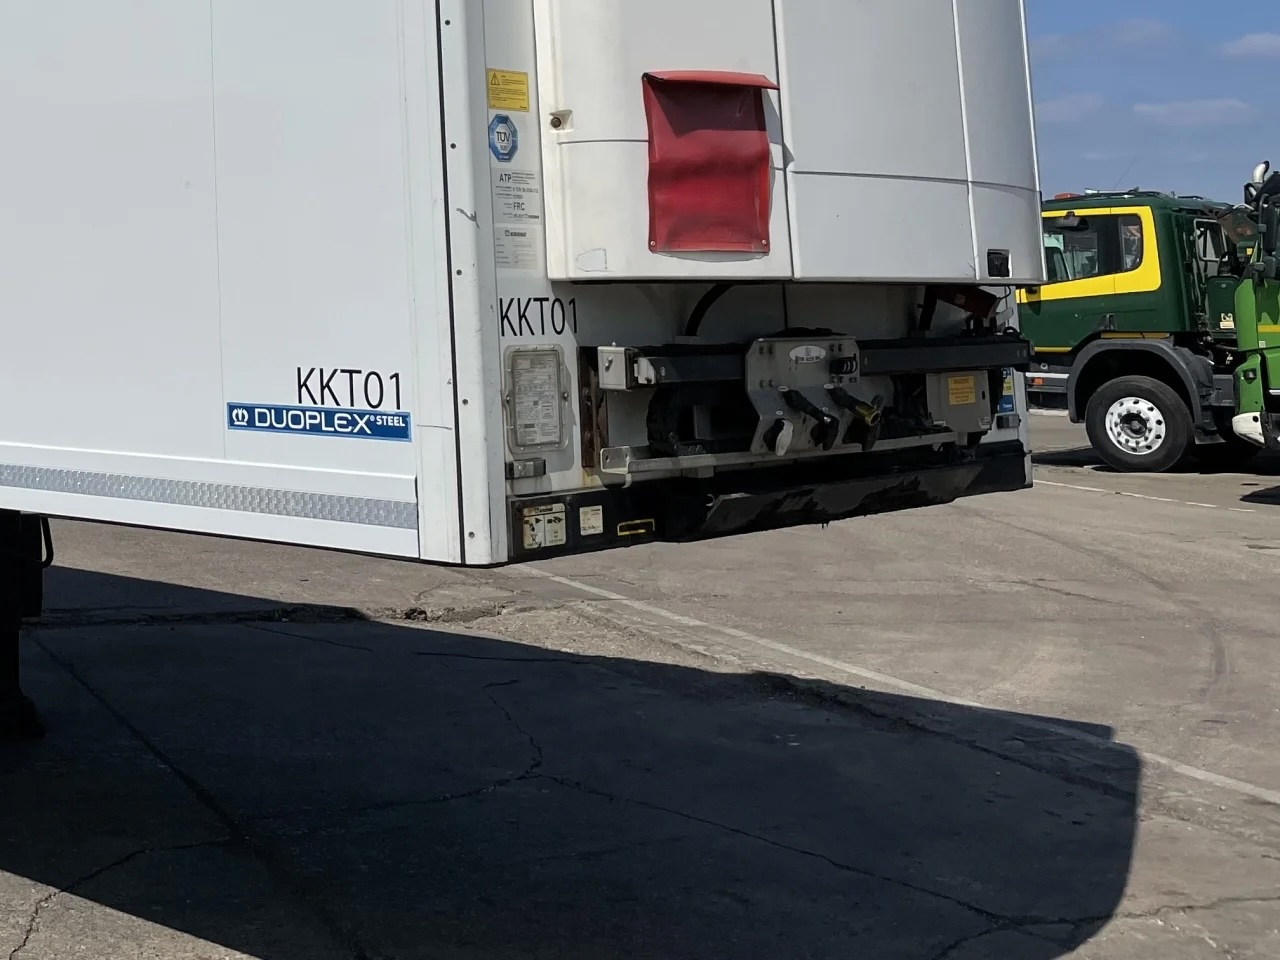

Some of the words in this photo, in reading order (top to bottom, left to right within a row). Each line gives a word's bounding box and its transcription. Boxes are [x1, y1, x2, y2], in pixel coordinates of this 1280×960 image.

[499, 173, 512, 183] ATP
[513, 202, 526, 211] FRC
[499, 297, 578, 337] KKT01
[296, 366, 402, 411] KKT01
[376, 415, 406, 427] STEEL
